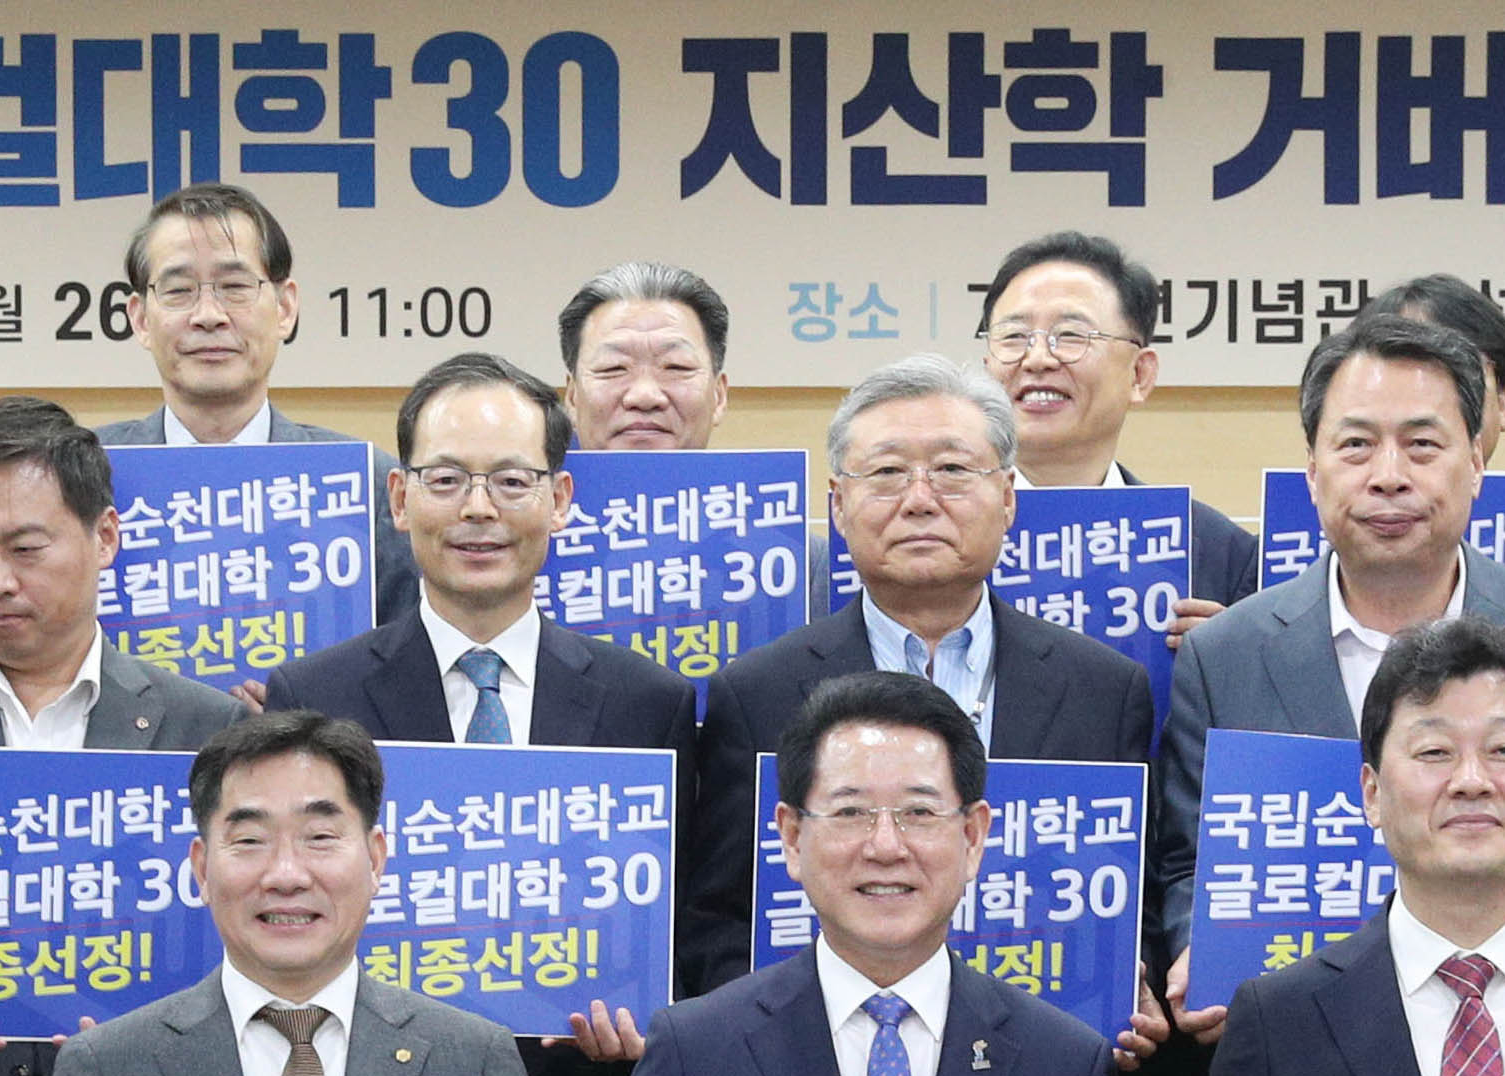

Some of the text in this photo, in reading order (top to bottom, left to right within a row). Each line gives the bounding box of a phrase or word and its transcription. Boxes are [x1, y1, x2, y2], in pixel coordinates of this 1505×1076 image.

[680, 28, 1163, 207] 지산학
[54, 282, 135, 341] 26
[328, 286, 492, 339] 11:00
[788, 281, 900, 343] 장소
[119, 472, 367, 550] 순천대학교
[550, 481, 803, 557] 순천대학교
[96, 536, 362, 617] 로컬대학 30
[533, 546, 796, 624] 컬대학 30
[1105, 582, 1181, 638] 30
[119, 611, 306, 676] 종선정!
[378, 783, 669, 858] 순천대학교
[136, 858, 204, 912] 30
[366, 852, 662, 925] 로컬대학 30
[1048, 865, 1128, 922] 30
[1205, 859, 1397, 920] 글로컬
[364, 927, 598, 996] 최종선정!
